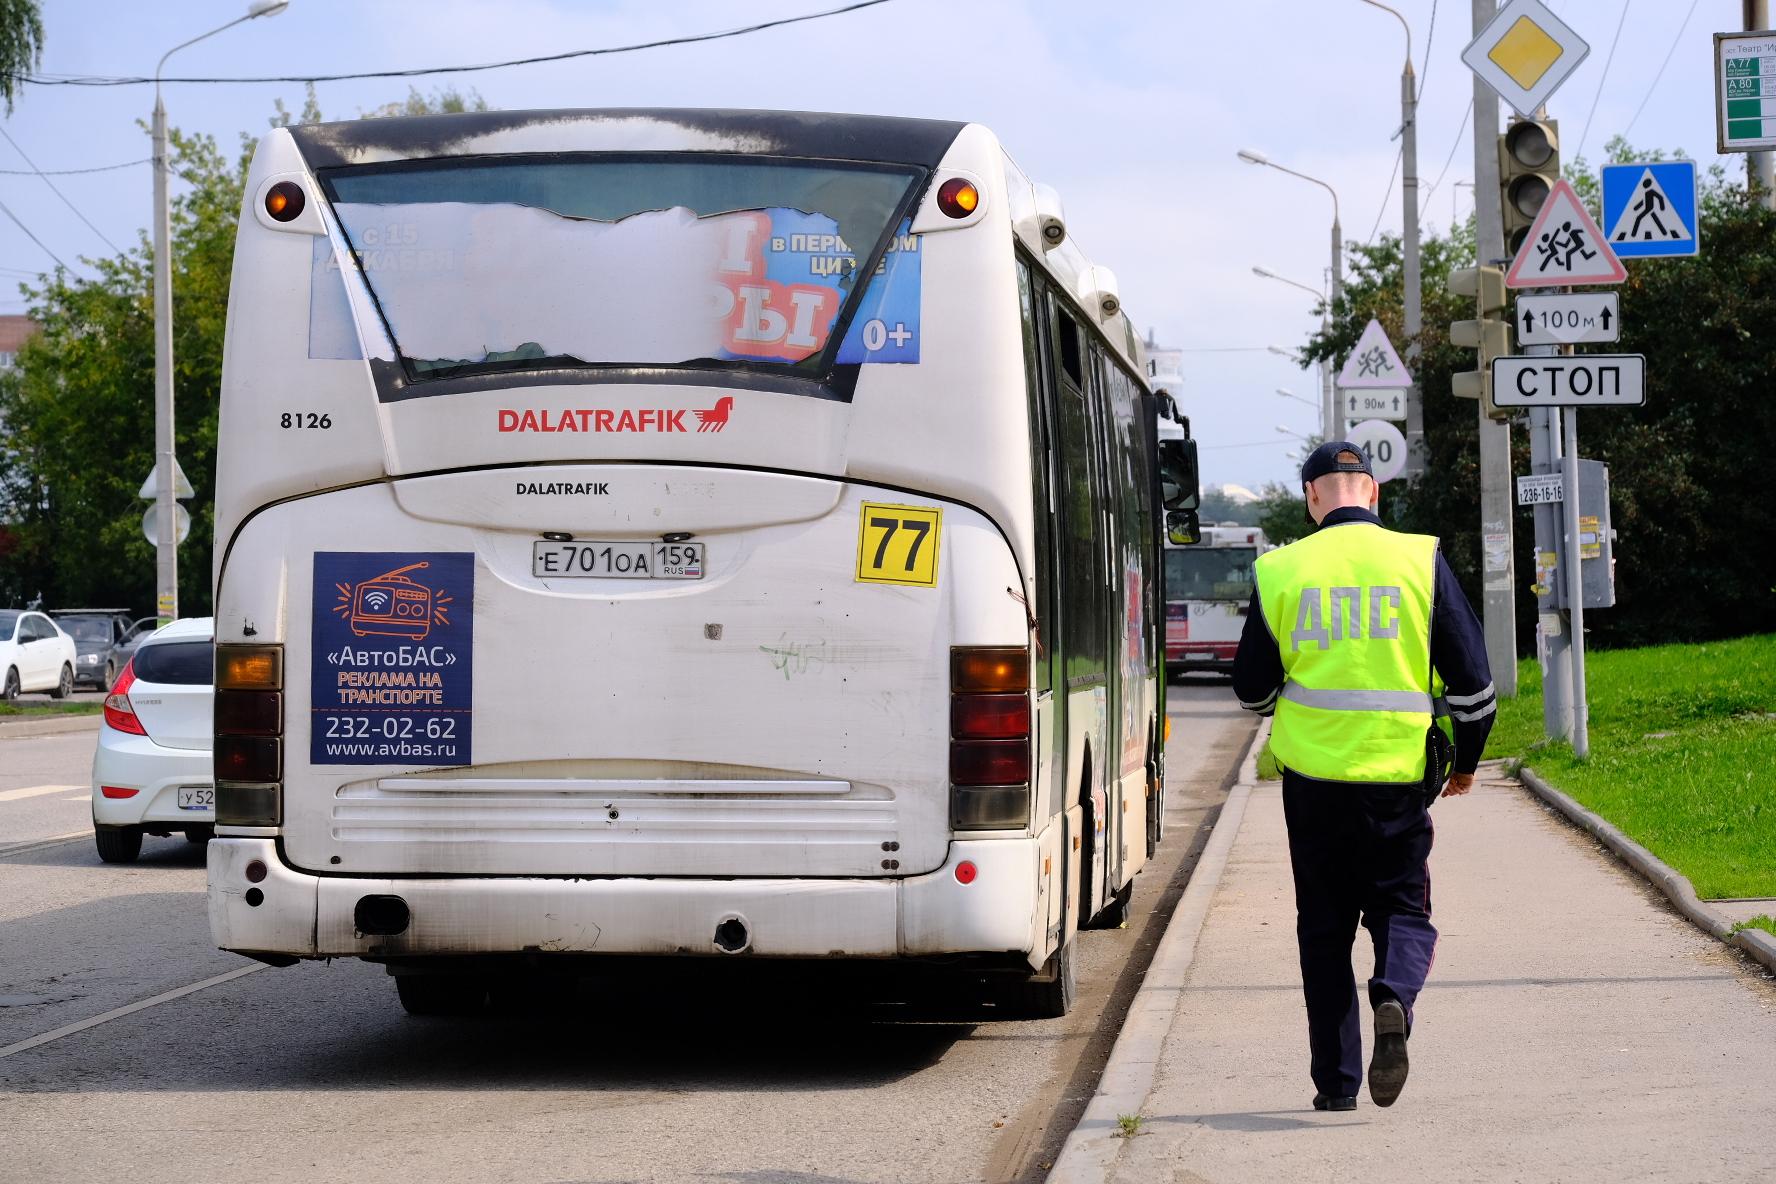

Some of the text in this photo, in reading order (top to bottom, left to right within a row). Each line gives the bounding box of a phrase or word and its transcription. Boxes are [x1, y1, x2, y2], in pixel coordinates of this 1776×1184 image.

[1737, 45, 1762, 54] Театр
[1739, 58, 1751, 68] 77
[1739, 79, 1752, 88] 80
[791, 234, 918, 251] ПЕРММ
[862, 320, 912, 350] 0+
[1516, 366, 1620, 397] СТОП
[280, 412, 332, 430] 8126
[498, 409, 687, 433] DALATRAFIK
[1362, 440, 1392, 463] 40
[516, 483, 609, 495] DALATRAFIK
[870, 517, 931, 571] 77
[657, 546, 696, 566] 159
[663, 567, 684, 575] RUS
[1291, 586, 1401, 652] ДПС
[327, 646, 457, 666] «АвтоБАС»
[337, 672, 442, 687] РЕКЛАМА НА
[337, 689, 443, 704] ТРАНСПОРТЕ
[325, 717, 456, 739] 232-02-62
[326, 741, 456, 757] www.avbas.ru
